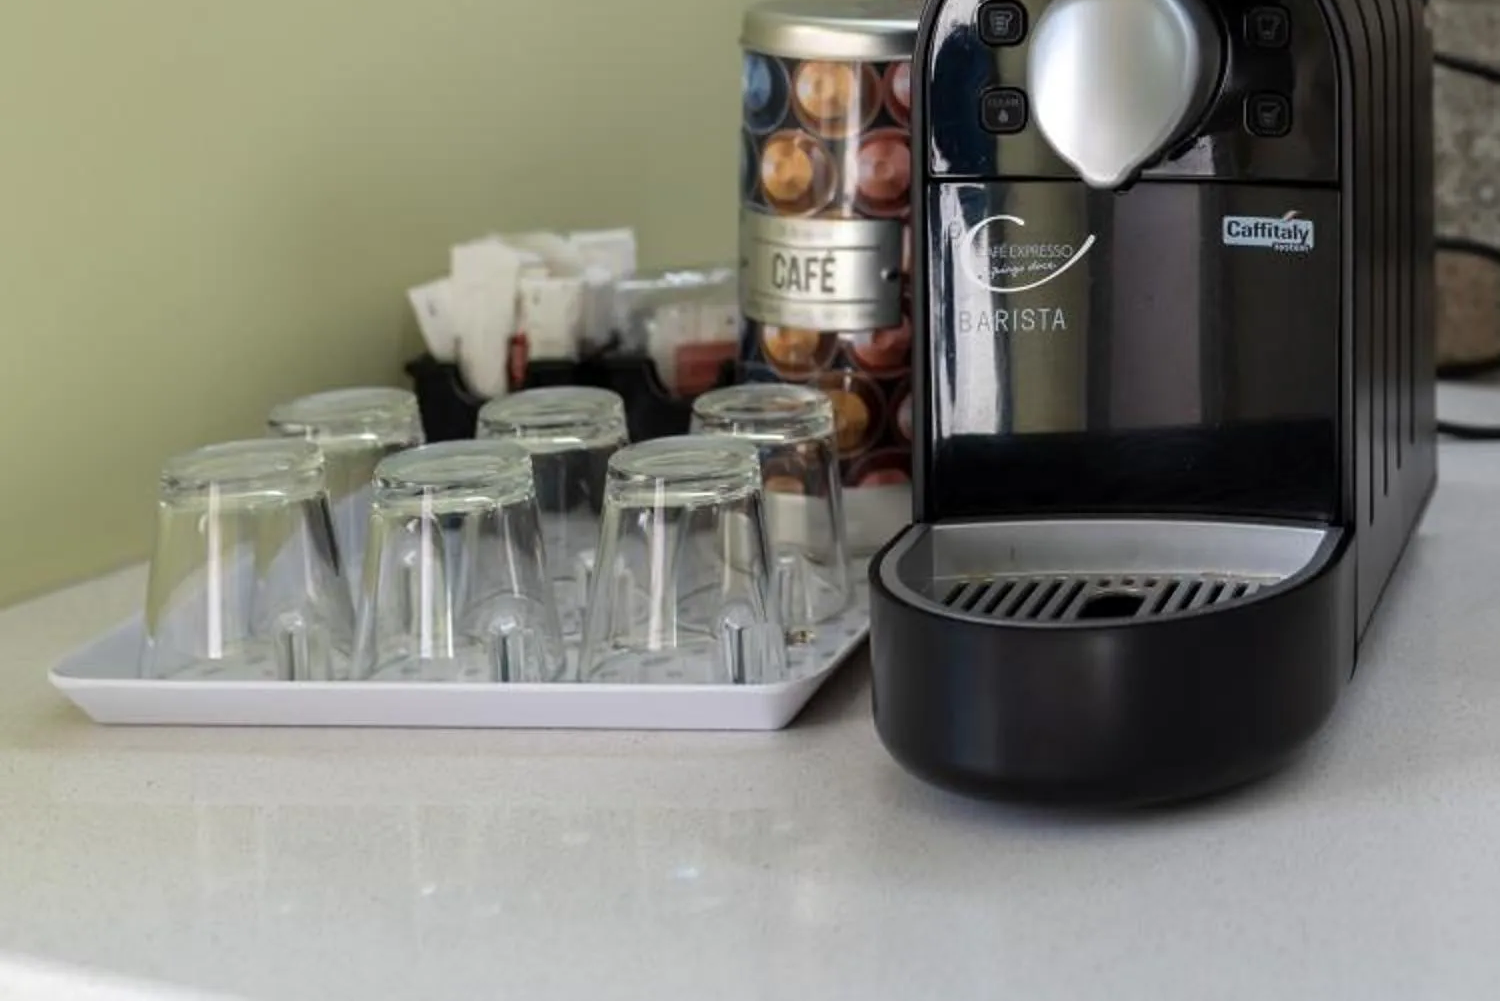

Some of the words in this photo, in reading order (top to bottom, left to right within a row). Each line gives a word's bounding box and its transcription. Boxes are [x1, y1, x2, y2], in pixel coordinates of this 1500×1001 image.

[1227, 220, 1309, 245] Caffitaly
[1009, 244, 1074, 259] EXPRESSO
[771, 249, 837, 293] CAFÉ
[959, 307, 1067, 333] BARISTA
